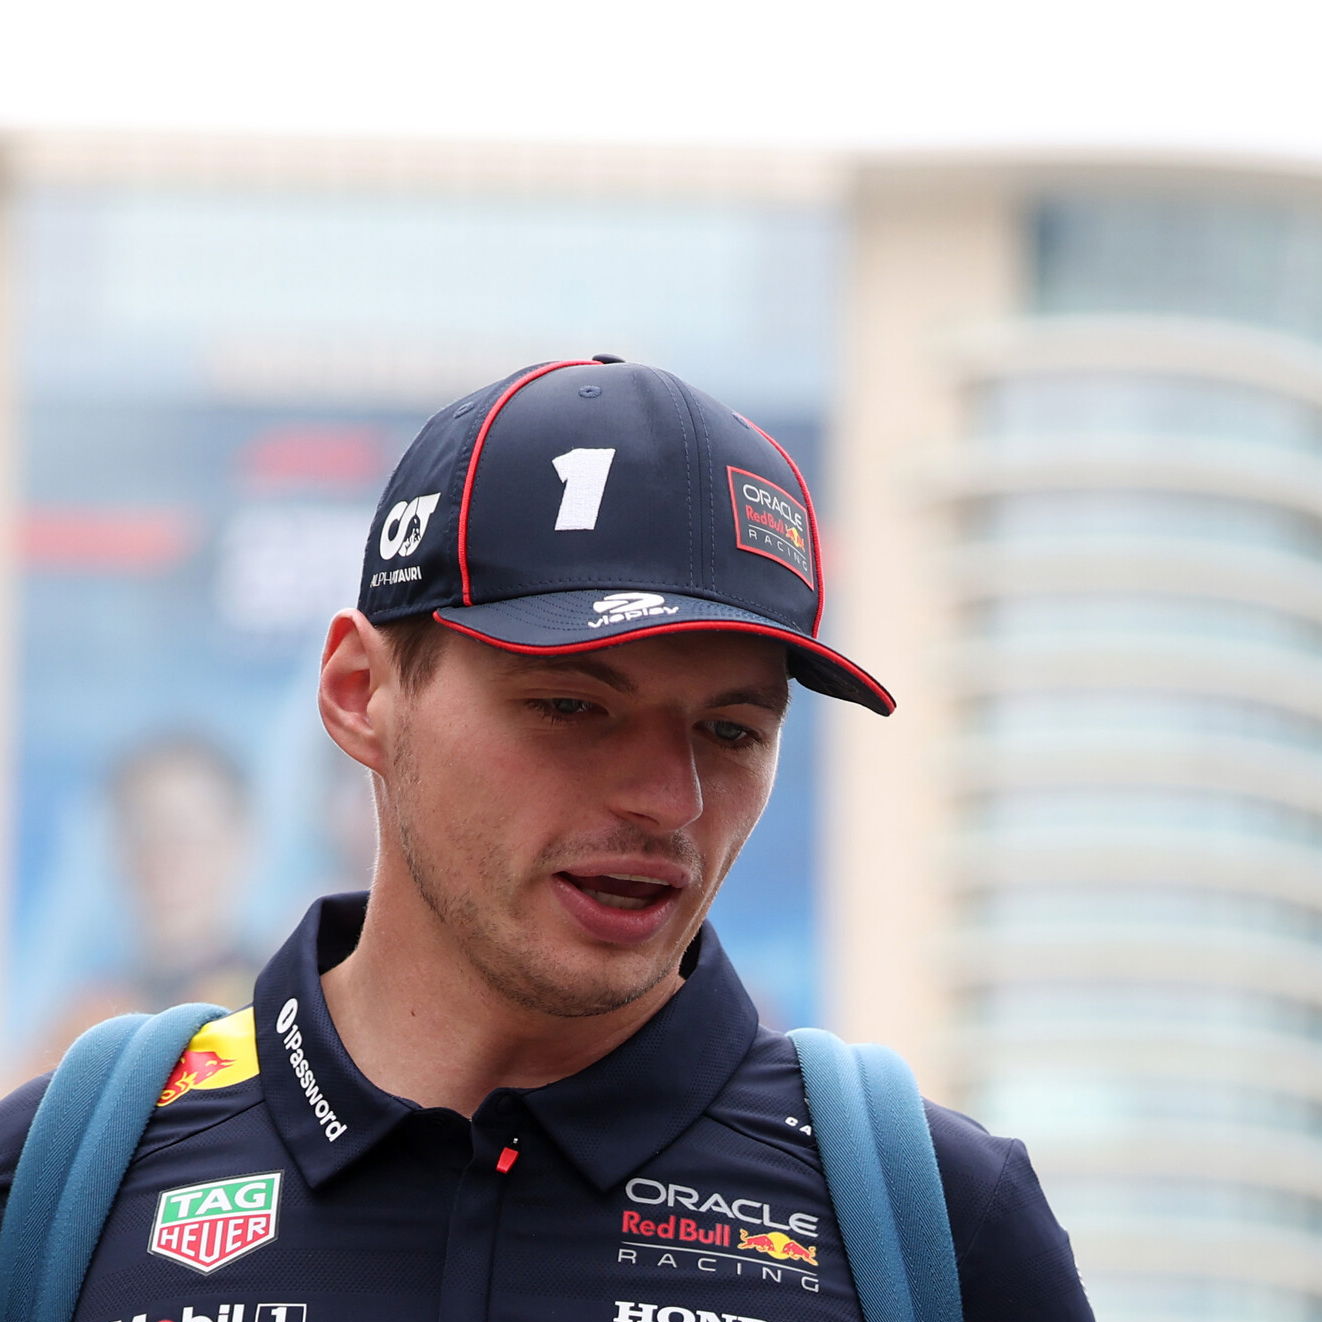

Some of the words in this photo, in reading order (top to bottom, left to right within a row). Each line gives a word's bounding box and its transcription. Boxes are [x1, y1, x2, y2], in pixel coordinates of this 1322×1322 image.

[552, 448, 616, 531] 1
[743, 484, 803, 531] ORACLE
[748, 529, 808, 571] RACING
[283, 1025, 347, 1142] 1Password
[170, 1182, 268, 1219] TAG
[625, 1178, 819, 1238] ORACLE
[161, 1219, 267, 1259] HEUER
[622, 1210, 676, 1239] Red
[678, 1218, 731, 1247] Bull
[618, 1248, 820, 1293] RACING
